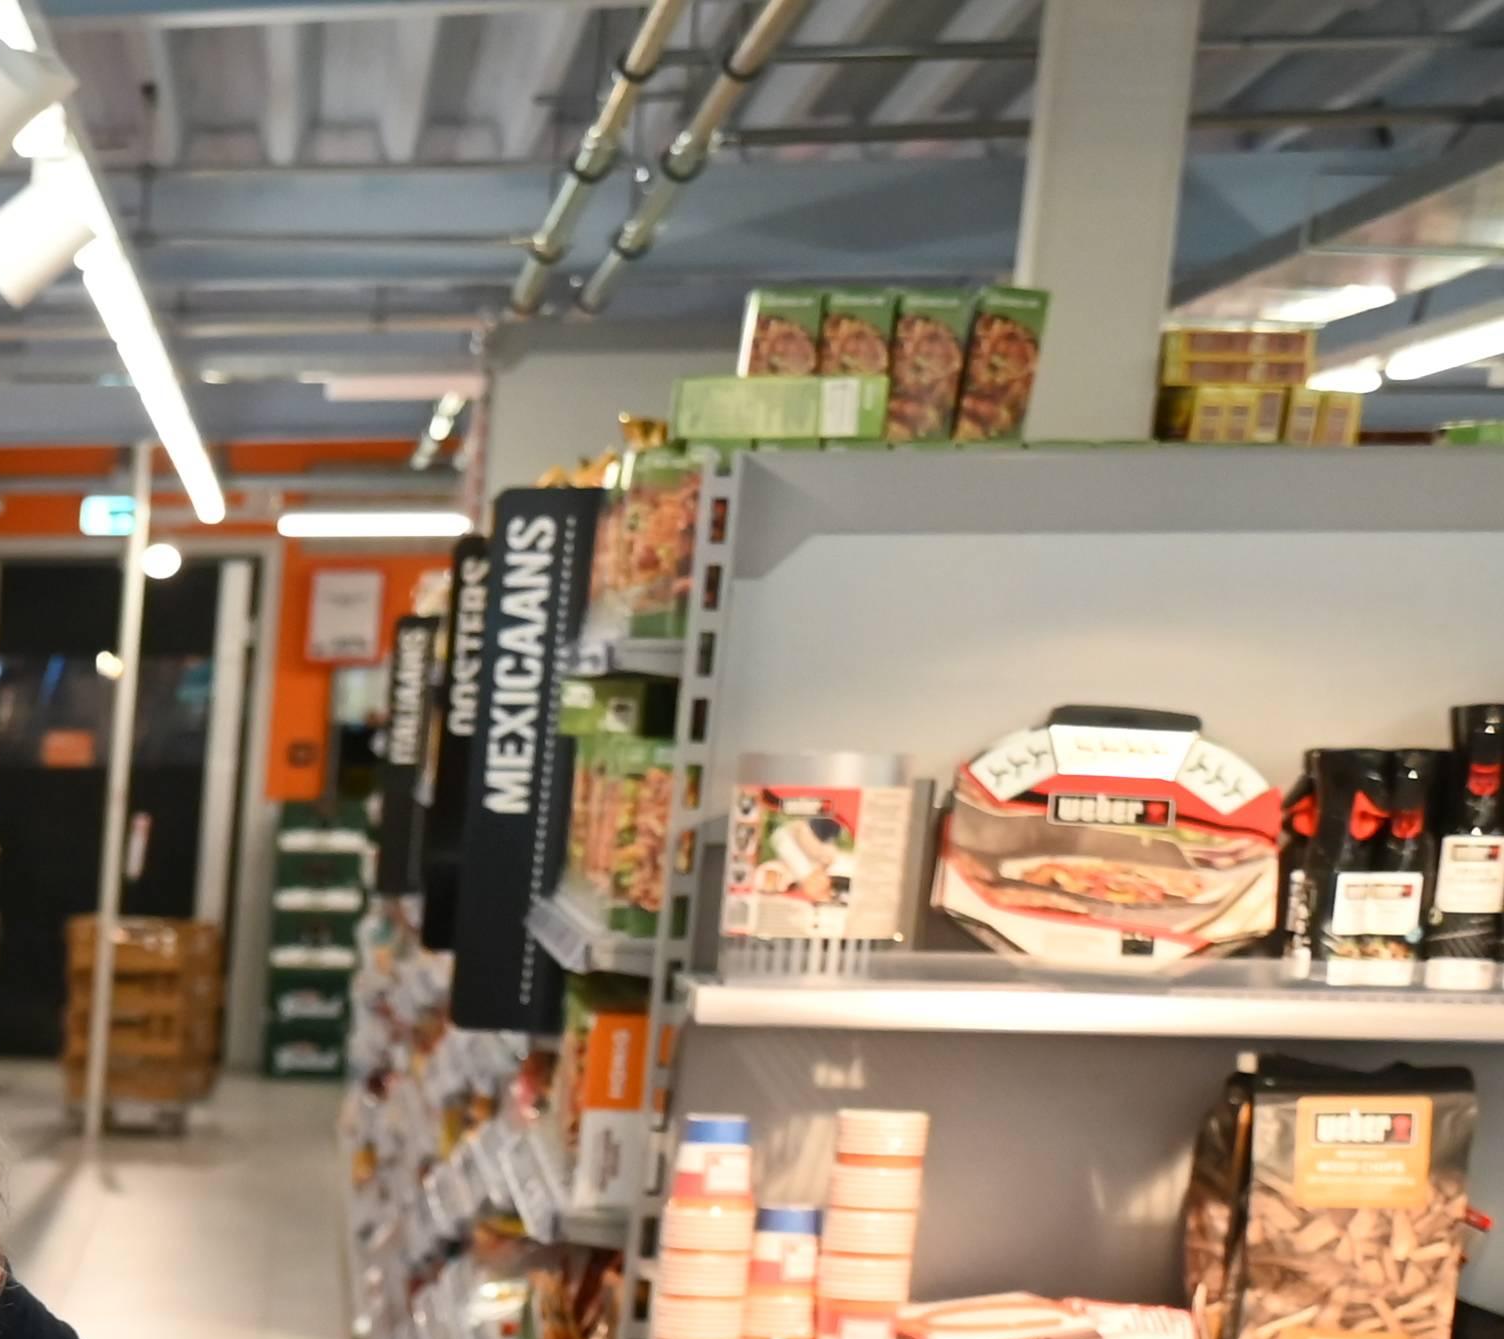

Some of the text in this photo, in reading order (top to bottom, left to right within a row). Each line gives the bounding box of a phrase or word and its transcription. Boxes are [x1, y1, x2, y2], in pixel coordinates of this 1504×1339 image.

[389, 625, 430, 766] ITALIAANS
[482, 514, 557, 815] MEXICAANS
[1057, 792, 1145, 825] weber
[1316, 1108, 1392, 1143] weber
